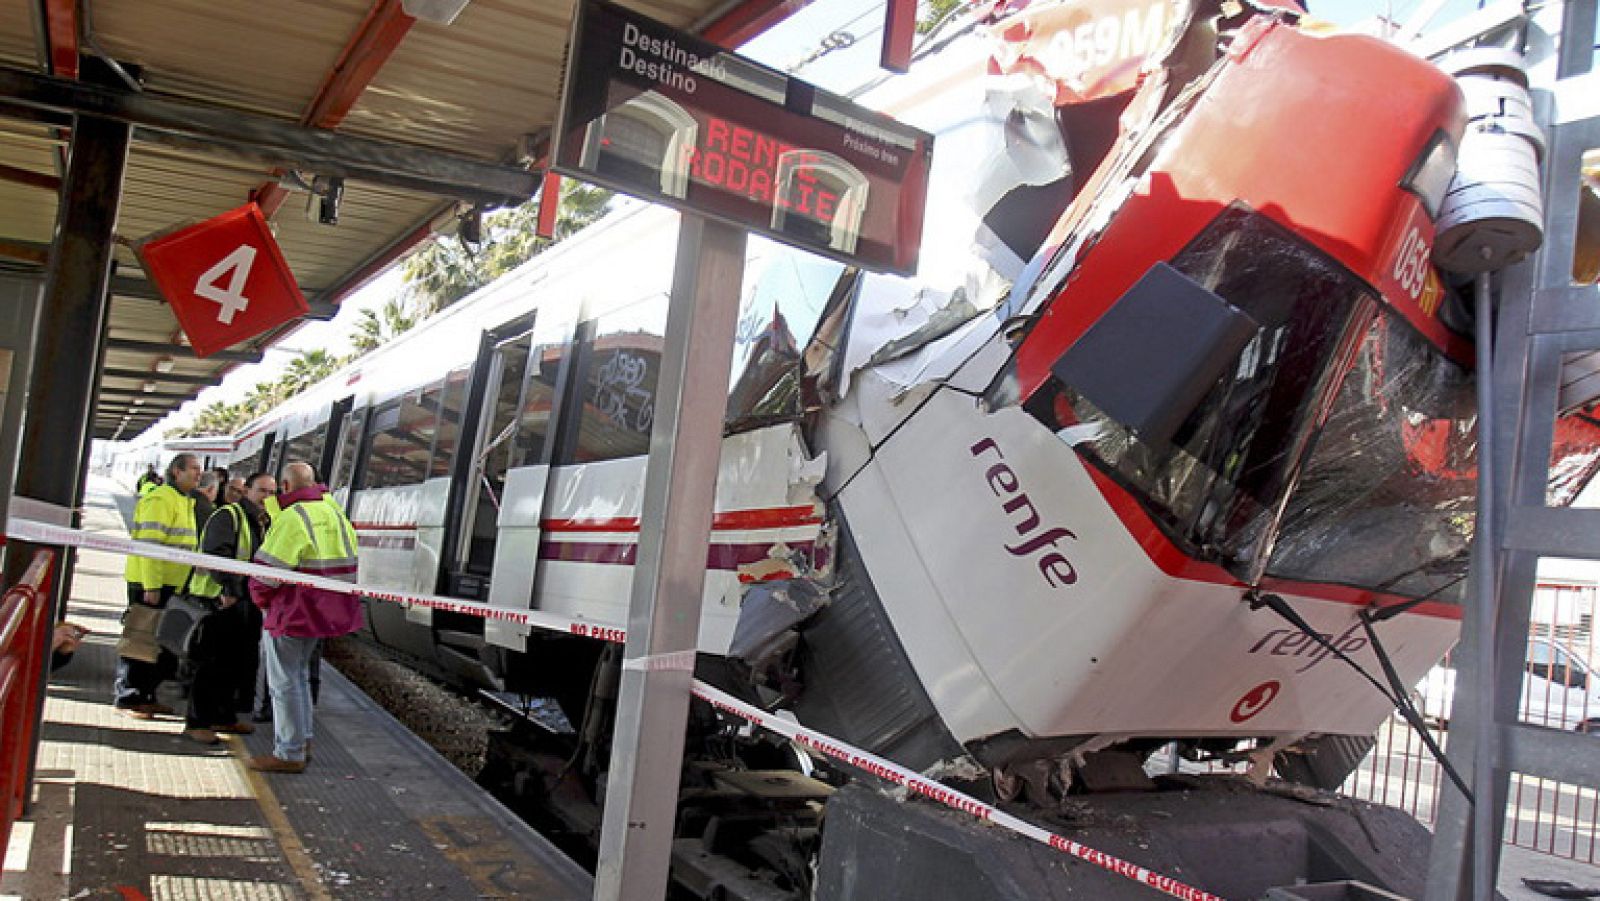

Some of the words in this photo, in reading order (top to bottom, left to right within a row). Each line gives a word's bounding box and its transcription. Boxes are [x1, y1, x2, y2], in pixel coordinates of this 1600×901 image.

[620, 47, 697, 93] Destino
[706, 117, 822, 184] RENFE
[193, 243, 257, 325] 4
[970, 437, 1078, 588] renfe
[570, 623, 588, 636] NO
[1249, 623, 1368, 673] renfe
